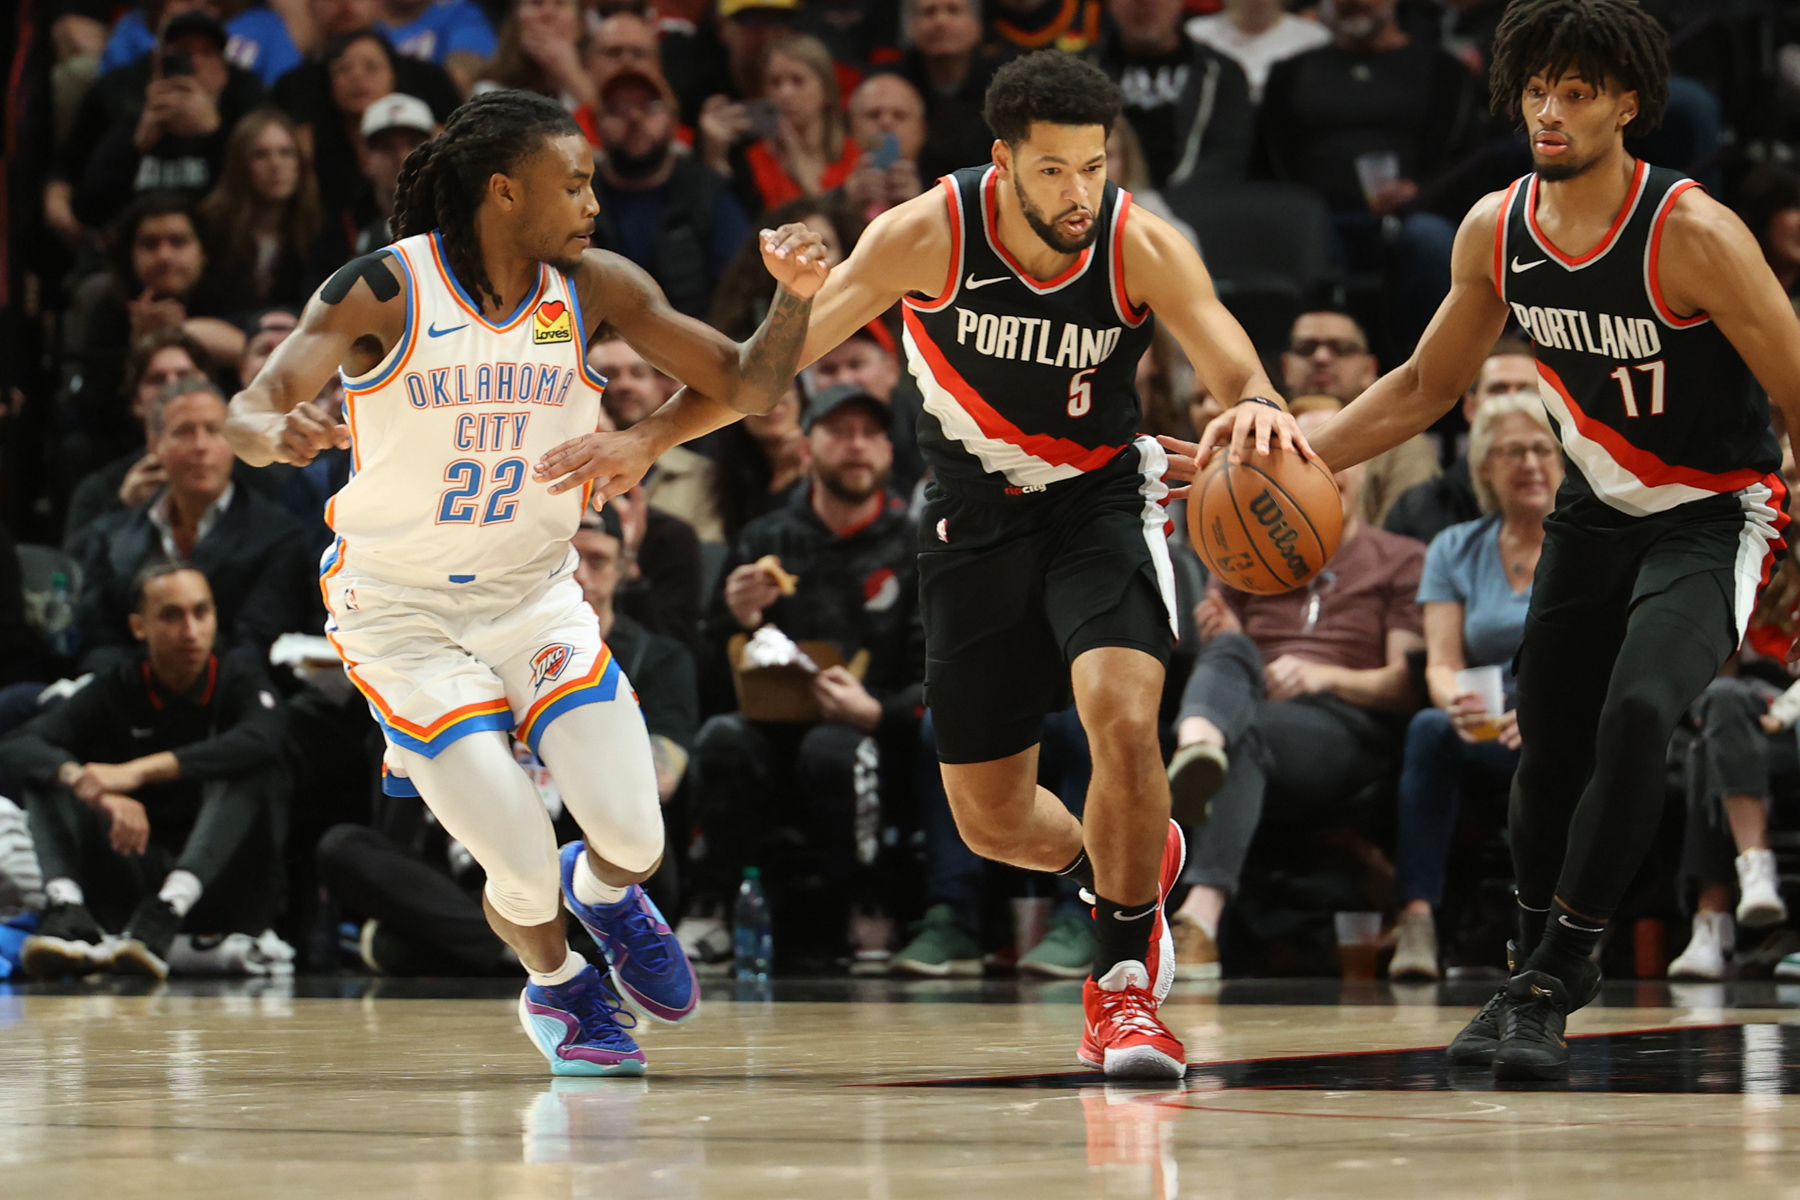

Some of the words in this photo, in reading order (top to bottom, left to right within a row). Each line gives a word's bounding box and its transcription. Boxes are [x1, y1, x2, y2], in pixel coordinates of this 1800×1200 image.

[954, 306, 1122, 369] PORTLAND
[1509, 301, 1662, 360] PORTLAND
[404, 362, 577, 410] OKLAHOMA
[1066, 368, 1097, 418] 5
[1610, 359, 1666, 418] 17
[454, 411, 531, 452] CITY
[435, 456, 529, 527] 22
[1249, 487, 1311, 580] Wilson
